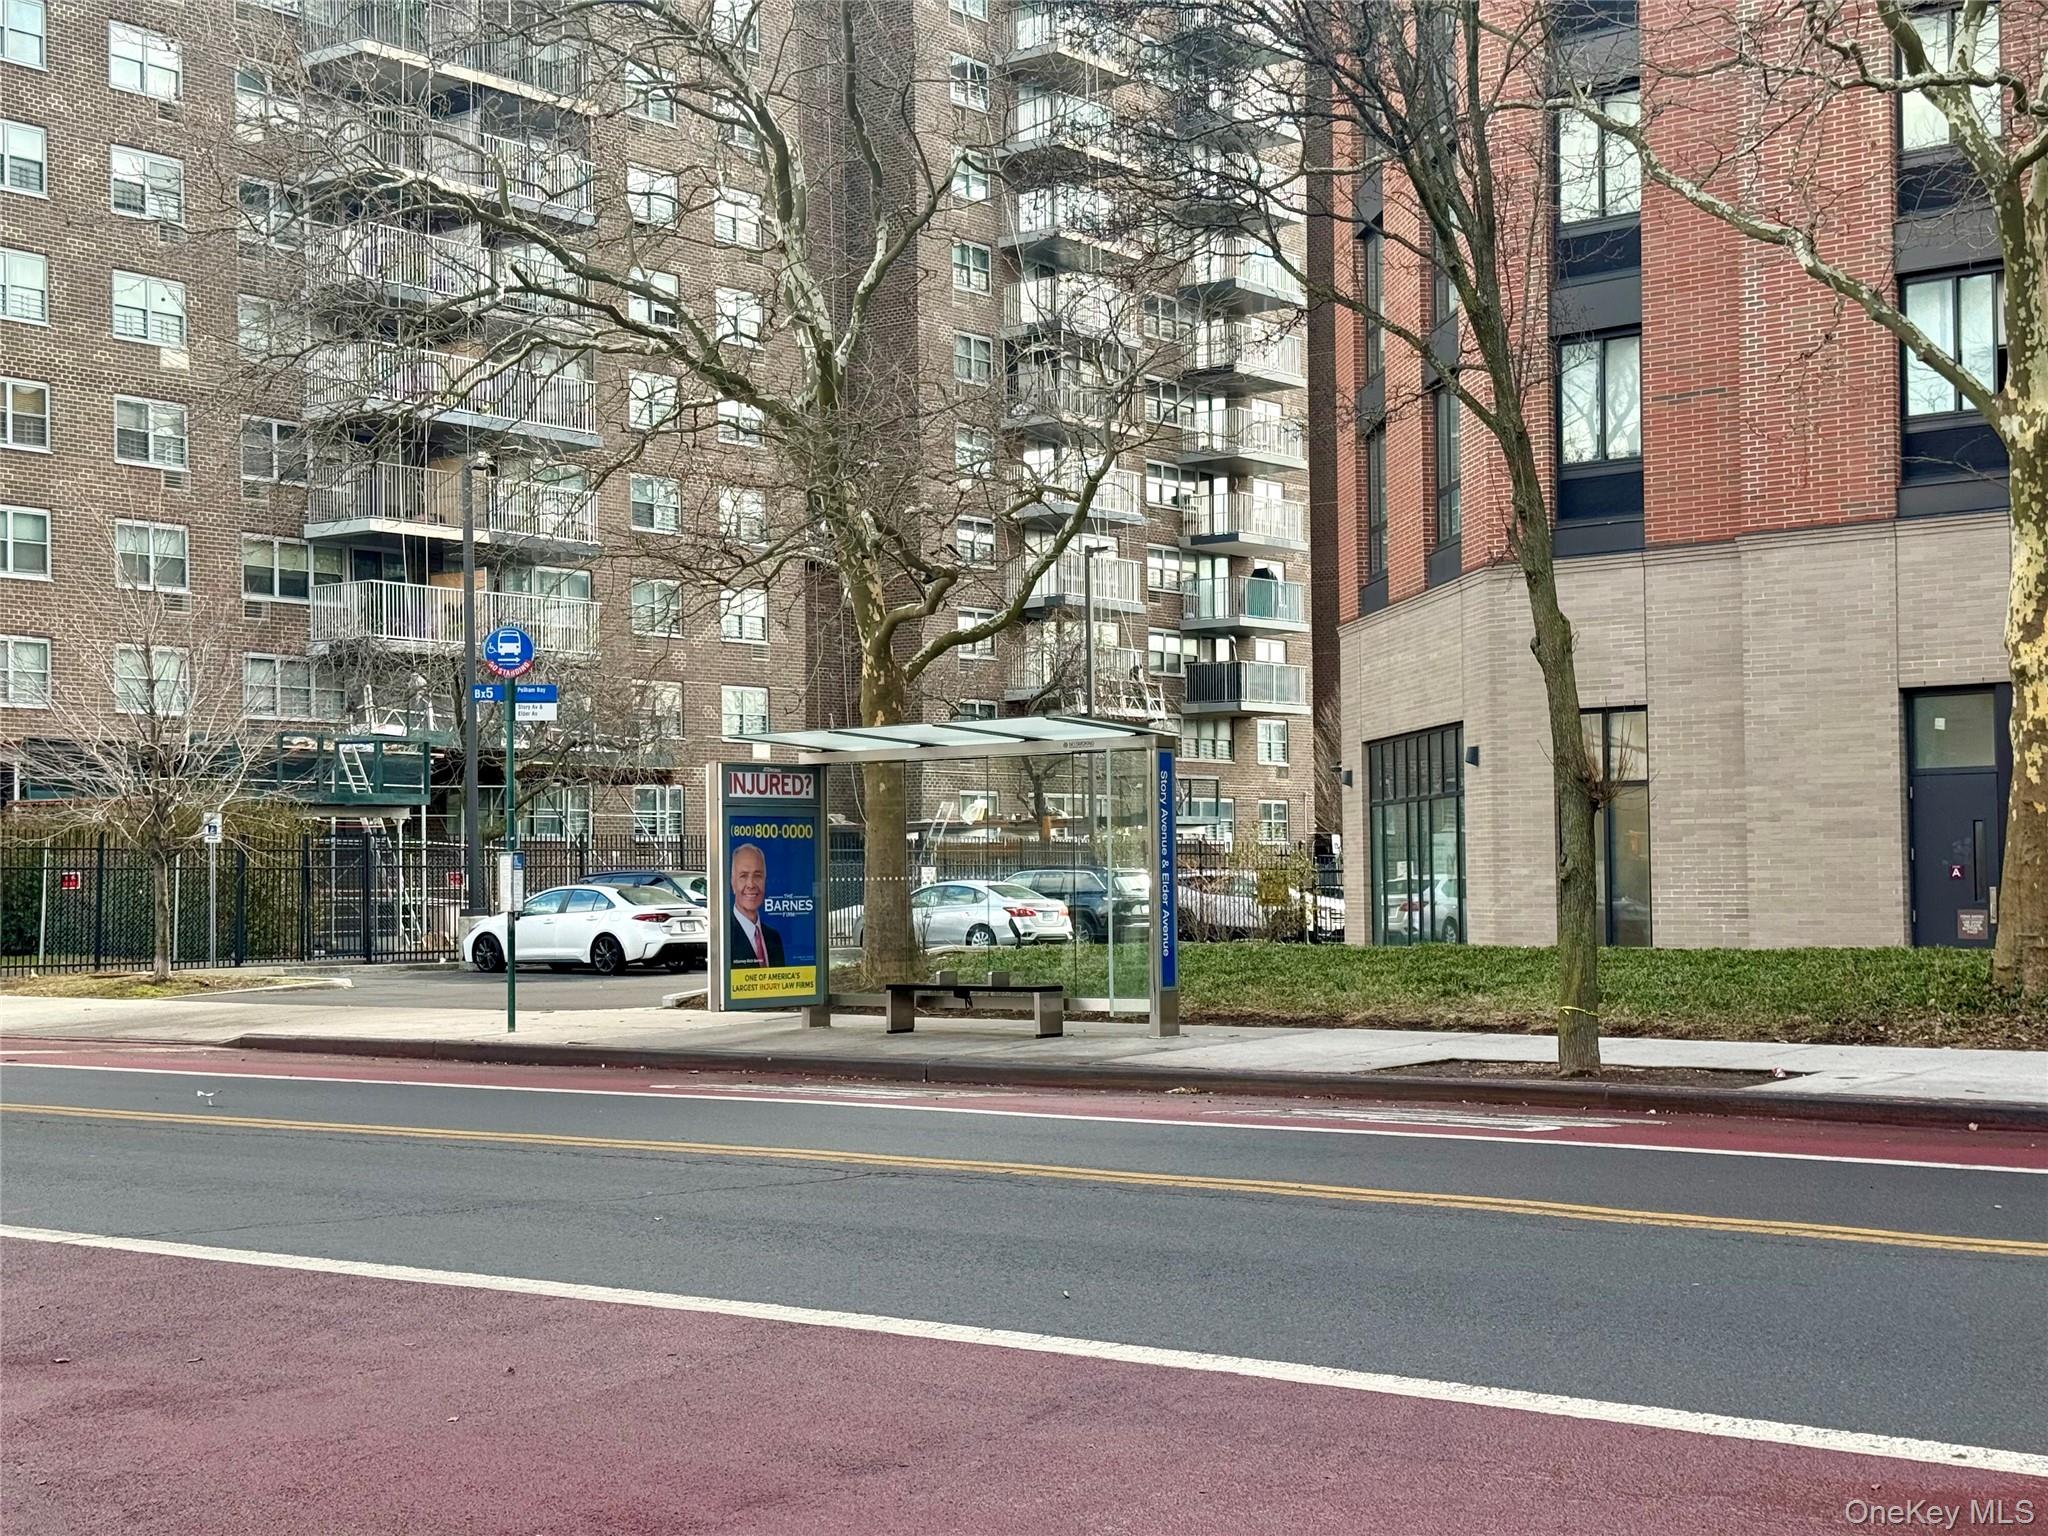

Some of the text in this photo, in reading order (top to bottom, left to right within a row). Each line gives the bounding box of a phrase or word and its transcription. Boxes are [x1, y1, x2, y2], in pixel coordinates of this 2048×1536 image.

[497, 661, 530, 677] STANDING
[474, 687, 494, 699] Bx5
[729, 773, 812, 796] INJURED?
[1160, 770, 1171, 957] Story Avenue & Elder Avenue
[1952, 868, 1961, 877] A
[764, 899, 814, 912] BARNES
[744, 972, 801, 982] ONE OF AMERICA'S
[732, 981, 814, 993] LARGEST INJURY LAW FIRMS
